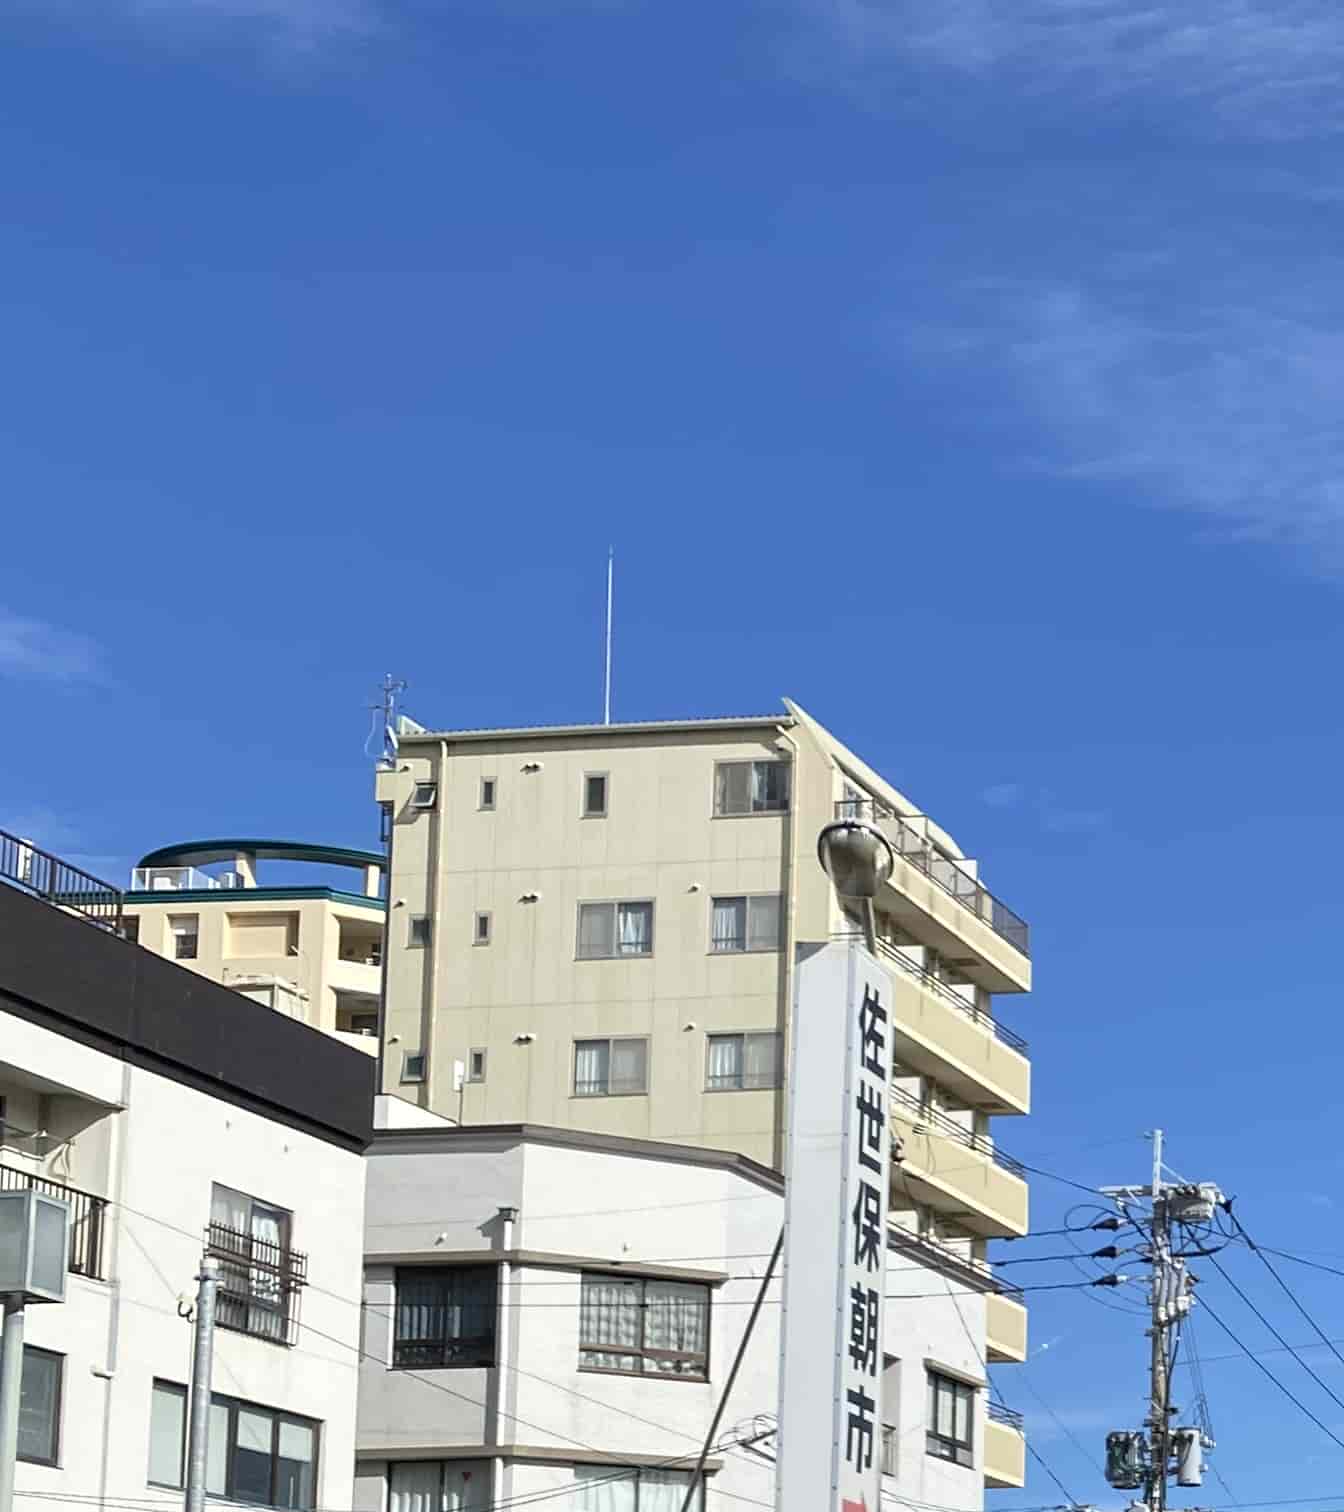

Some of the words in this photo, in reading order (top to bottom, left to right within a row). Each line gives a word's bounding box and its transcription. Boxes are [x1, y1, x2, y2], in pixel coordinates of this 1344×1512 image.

[845, 982, 888, 1474] 佐世保朝市
